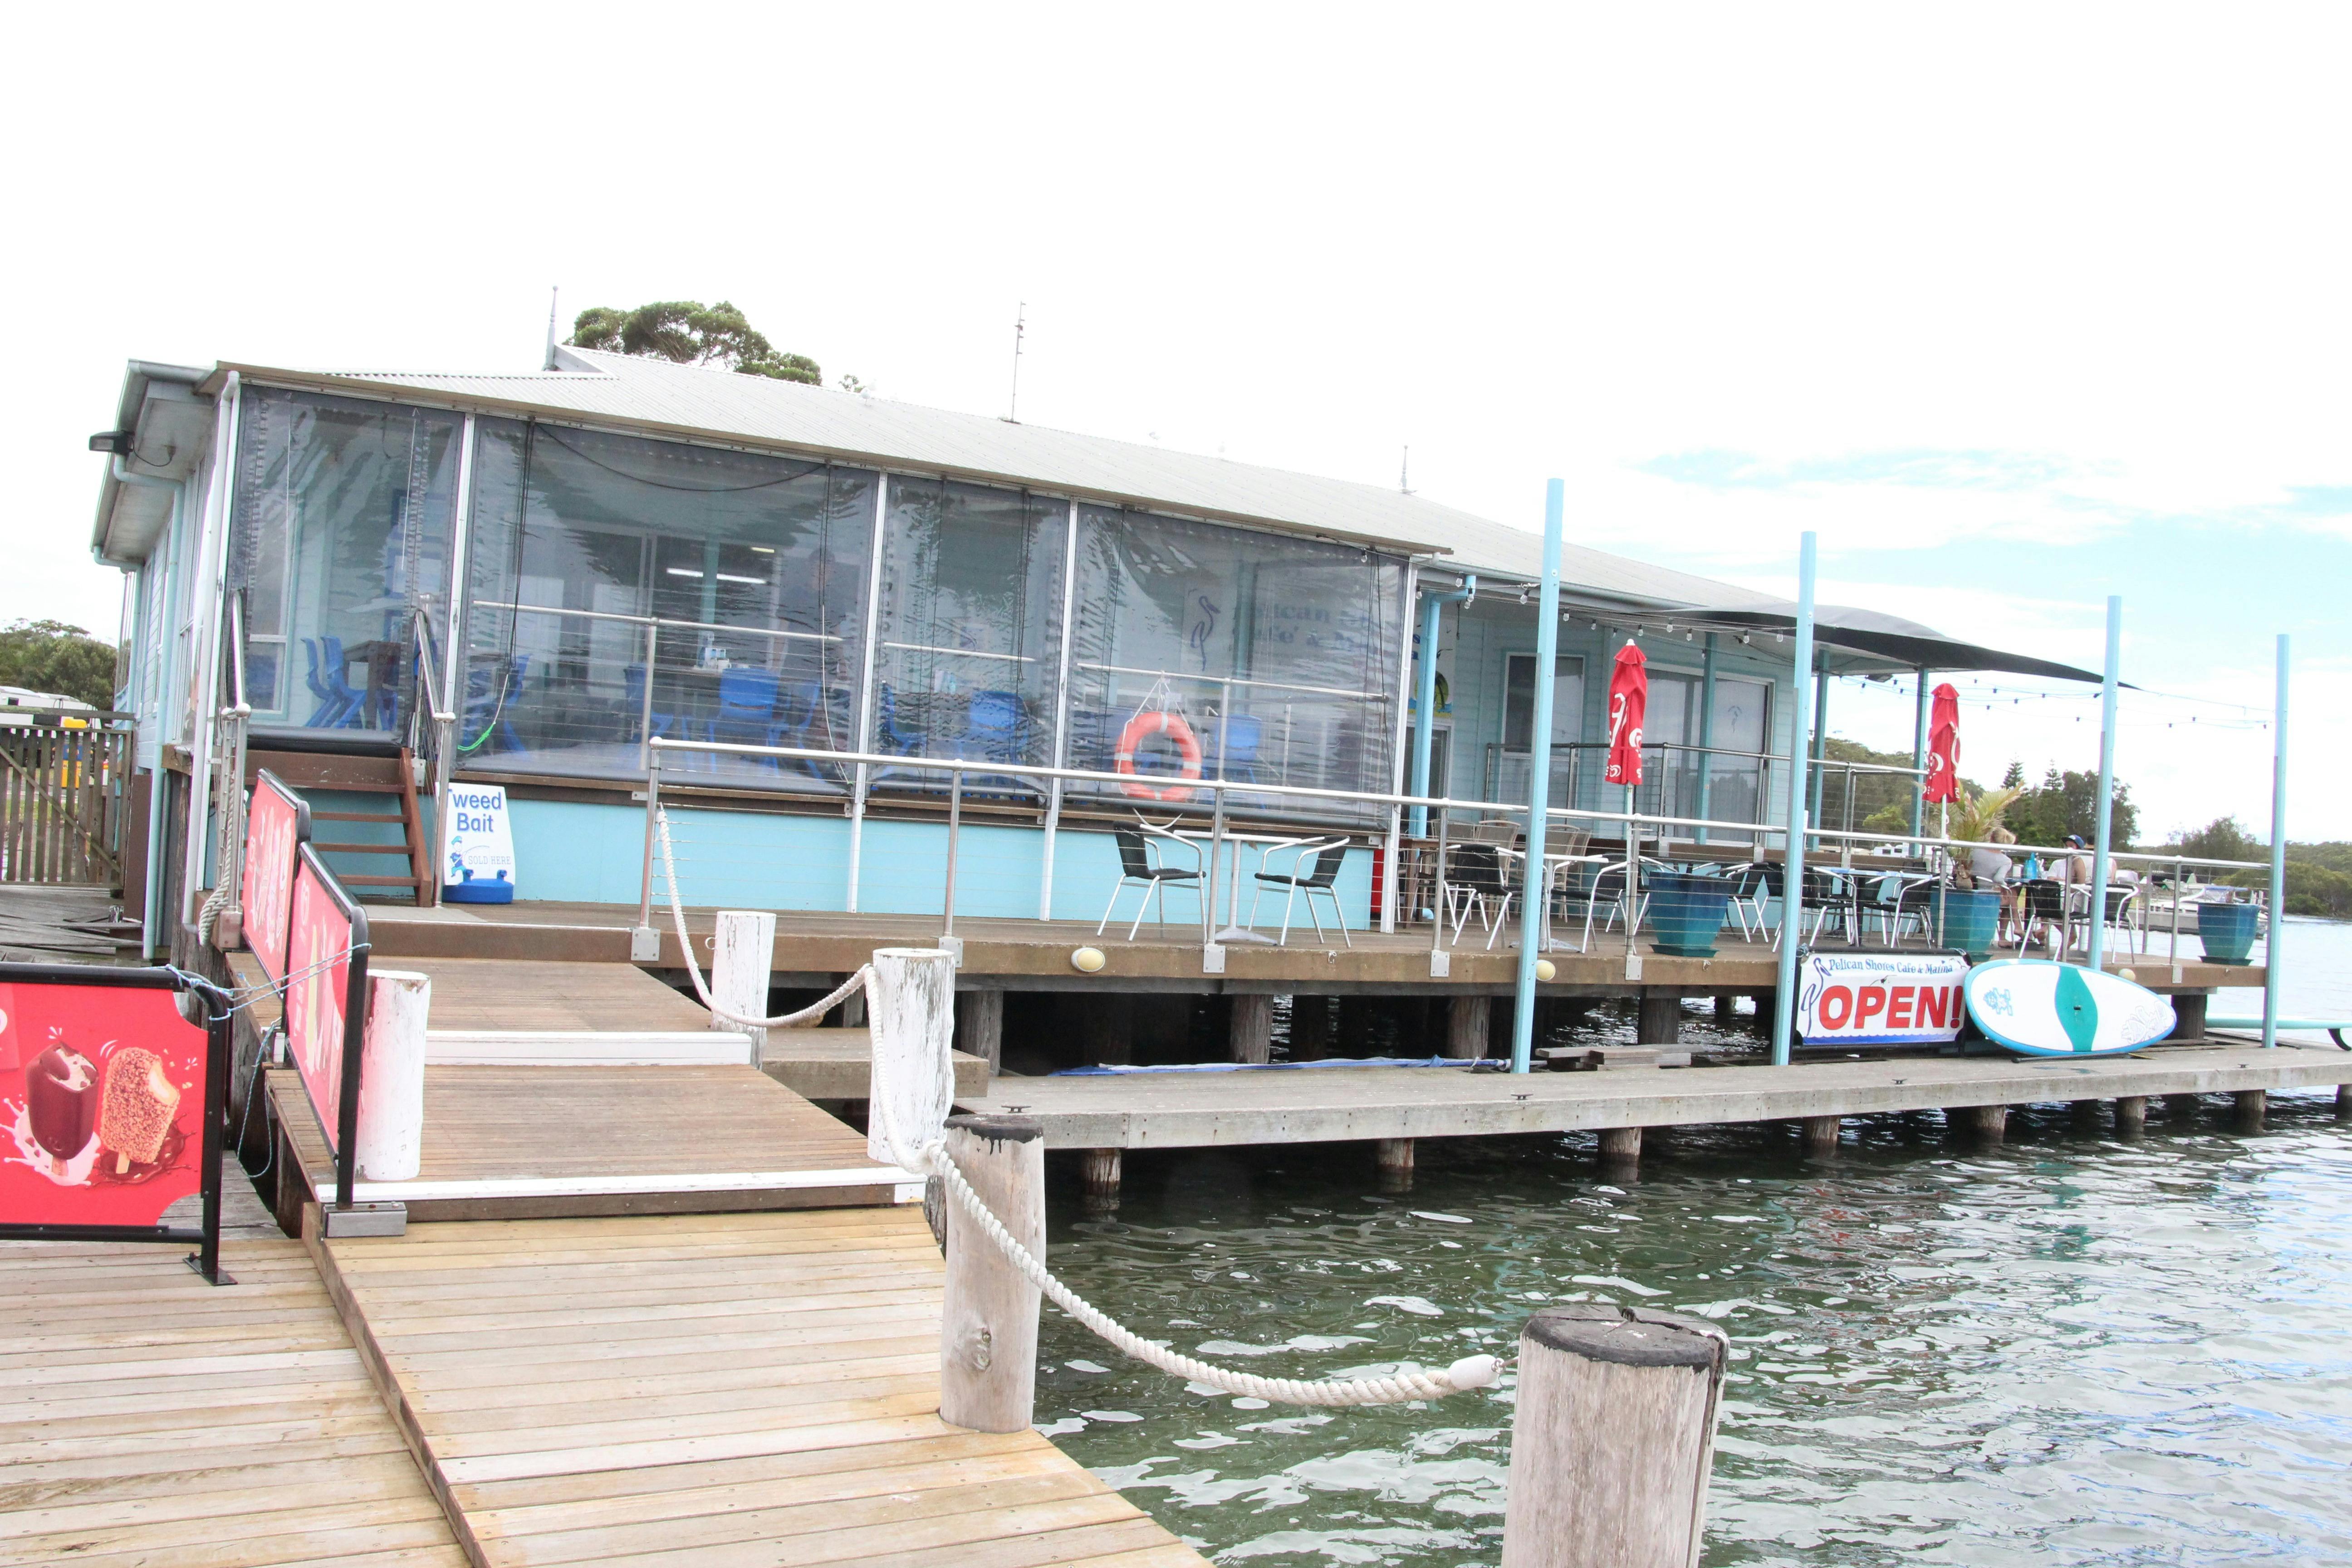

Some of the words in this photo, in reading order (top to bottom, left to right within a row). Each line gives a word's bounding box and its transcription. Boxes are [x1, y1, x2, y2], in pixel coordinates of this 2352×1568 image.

[457, 812, 494, 832] Bait
[468, 855, 488, 865] SOLD
[490, 856, 512, 865] HERE
[1829, 958, 1864, 971] Pelican
[1865, 958, 1895, 972] Shores
[1896, 961, 1916, 973] Cafe
[1925, 960, 1953, 975] Marina
[1818, 985, 1964, 1030] OPEN!
